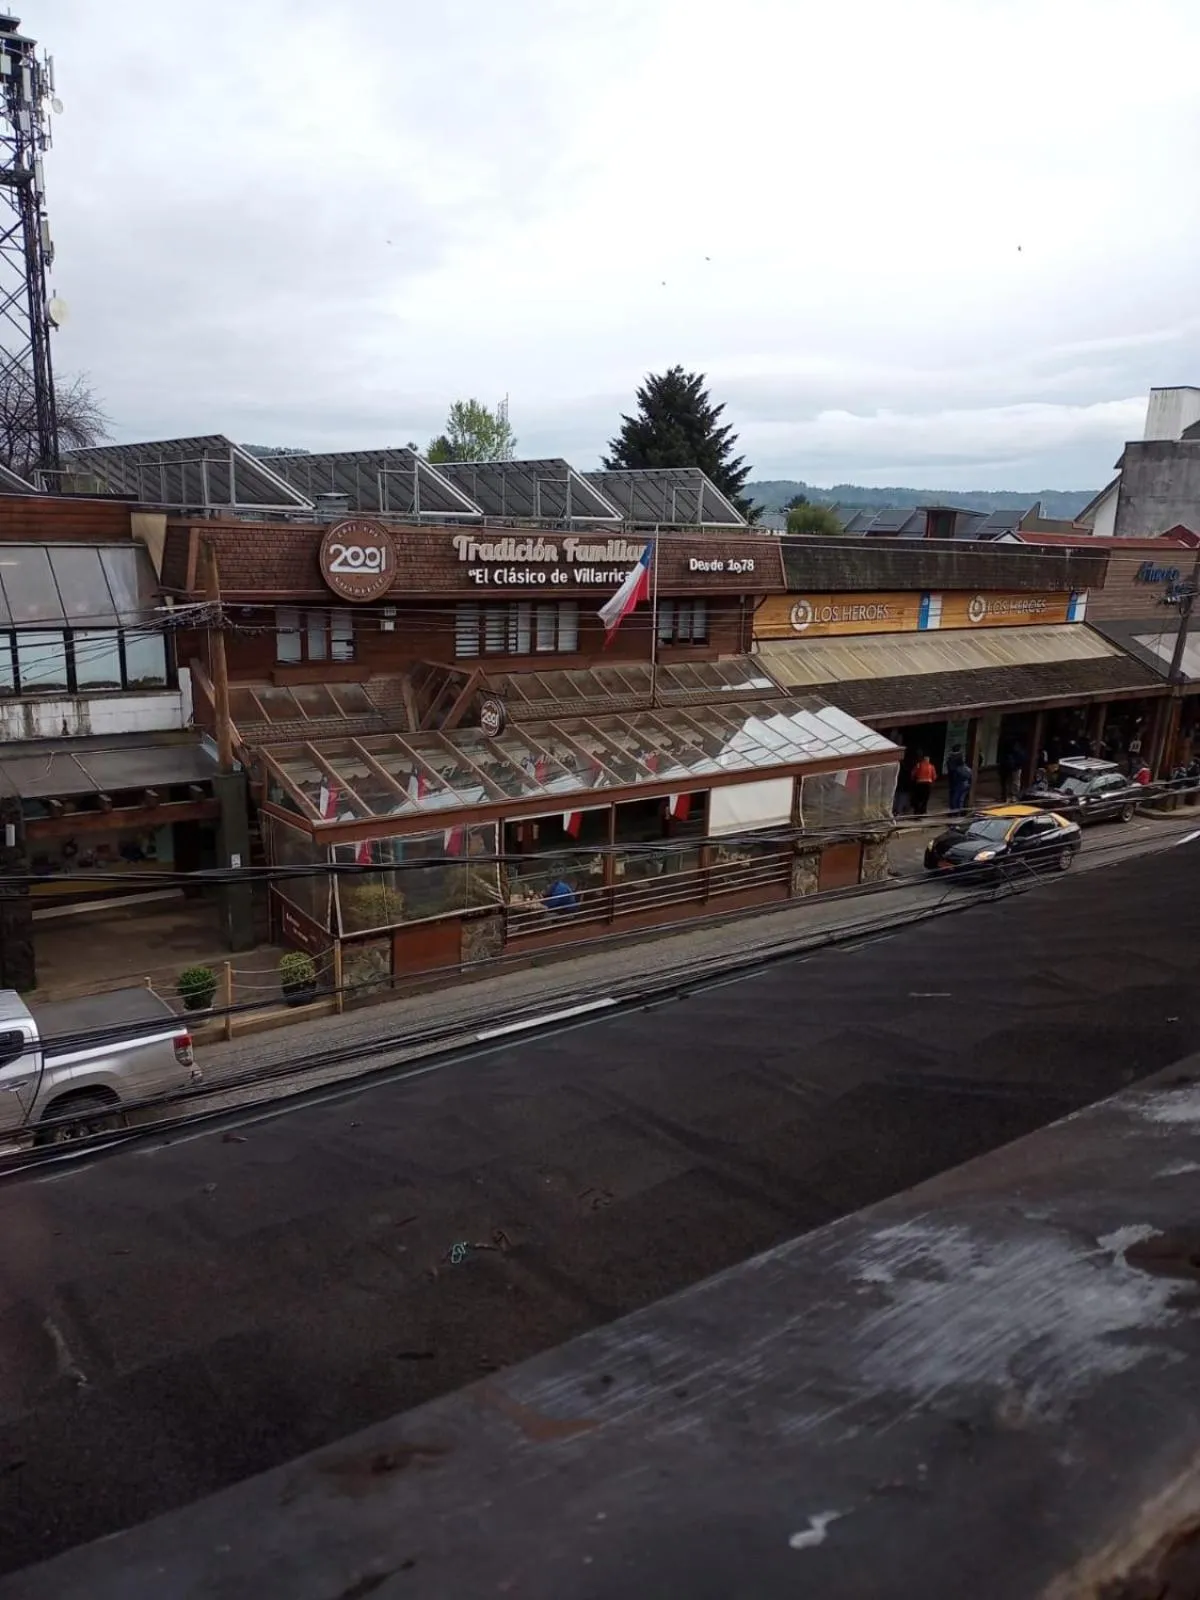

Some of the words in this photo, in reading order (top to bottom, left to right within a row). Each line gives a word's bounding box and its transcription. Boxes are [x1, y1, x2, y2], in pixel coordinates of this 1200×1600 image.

[452, 535, 559, 561] Tradición
[329, 543, 386, 573] 2001
[689, 558, 723, 571] Desde
[727, 559, 754, 574] 1978
[493, 567, 546, 585] Clásico
[550, 568, 568, 584] de
[813, 605, 840, 623] LOS
[842, 604, 889, 621] HEROES
